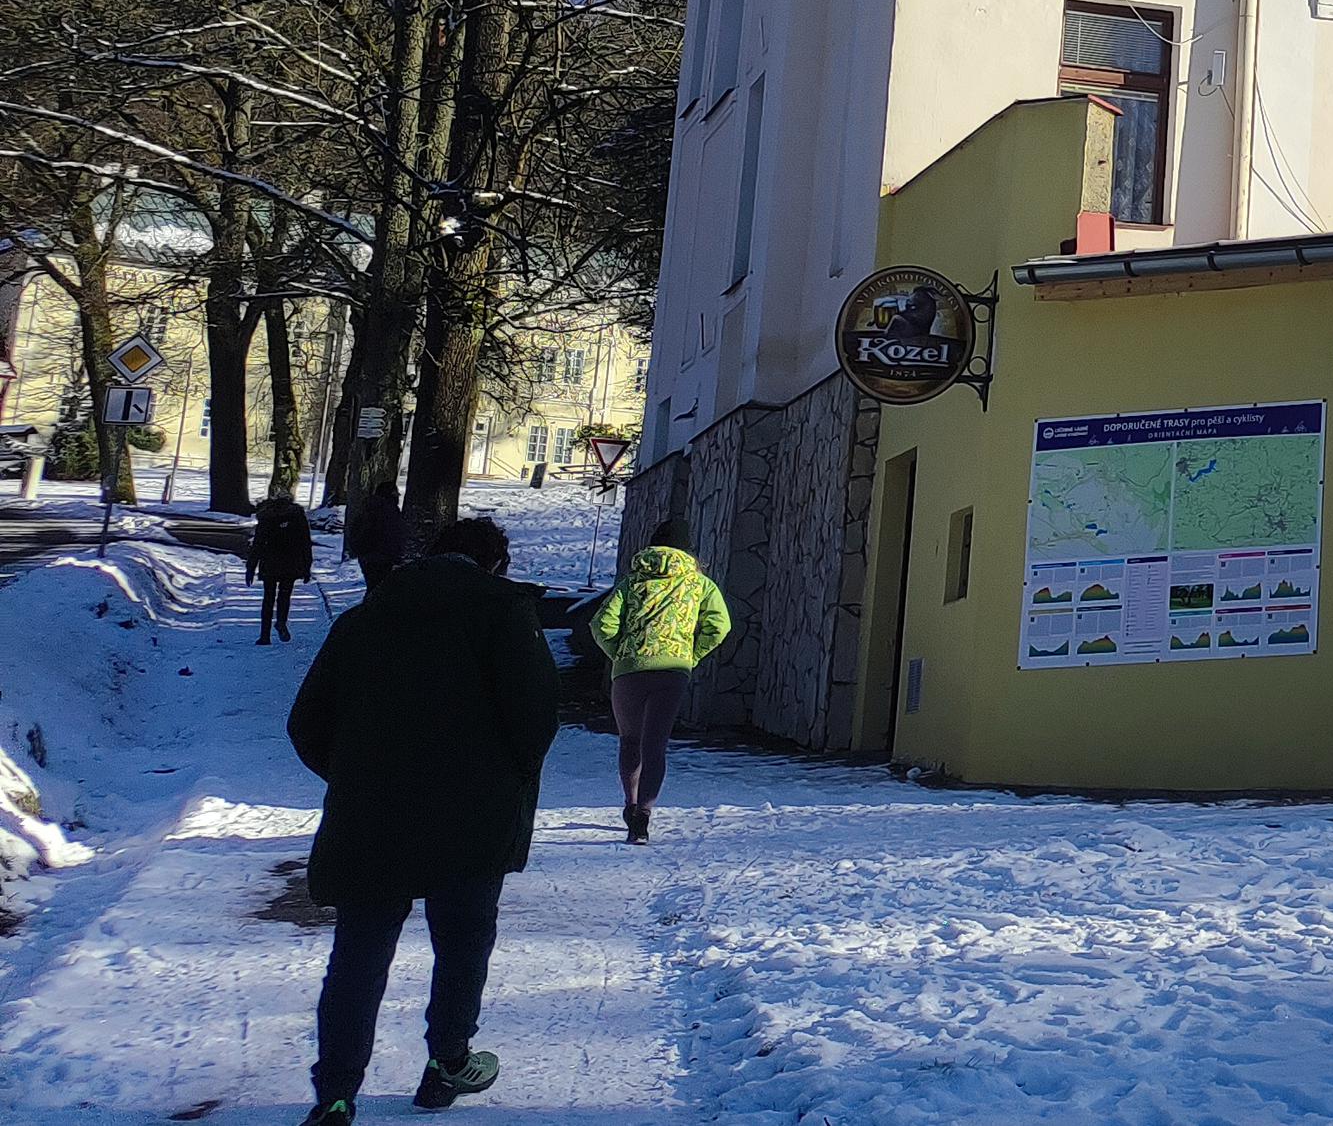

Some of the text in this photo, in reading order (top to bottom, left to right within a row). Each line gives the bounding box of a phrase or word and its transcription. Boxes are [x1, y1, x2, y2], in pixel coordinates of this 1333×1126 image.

[855, 337, 949, 366] Kozel
[1103, 418, 1161, 432] DOPORUČENÉ
[1163, 417, 1190, 428] TRASY
[1190, 418, 1206, 428] pro
[1207, 415, 1225, 427] pěší
[1233, 412, 1265, 425] cyklisty
[1196, 427, 1218, 435] MAPA
